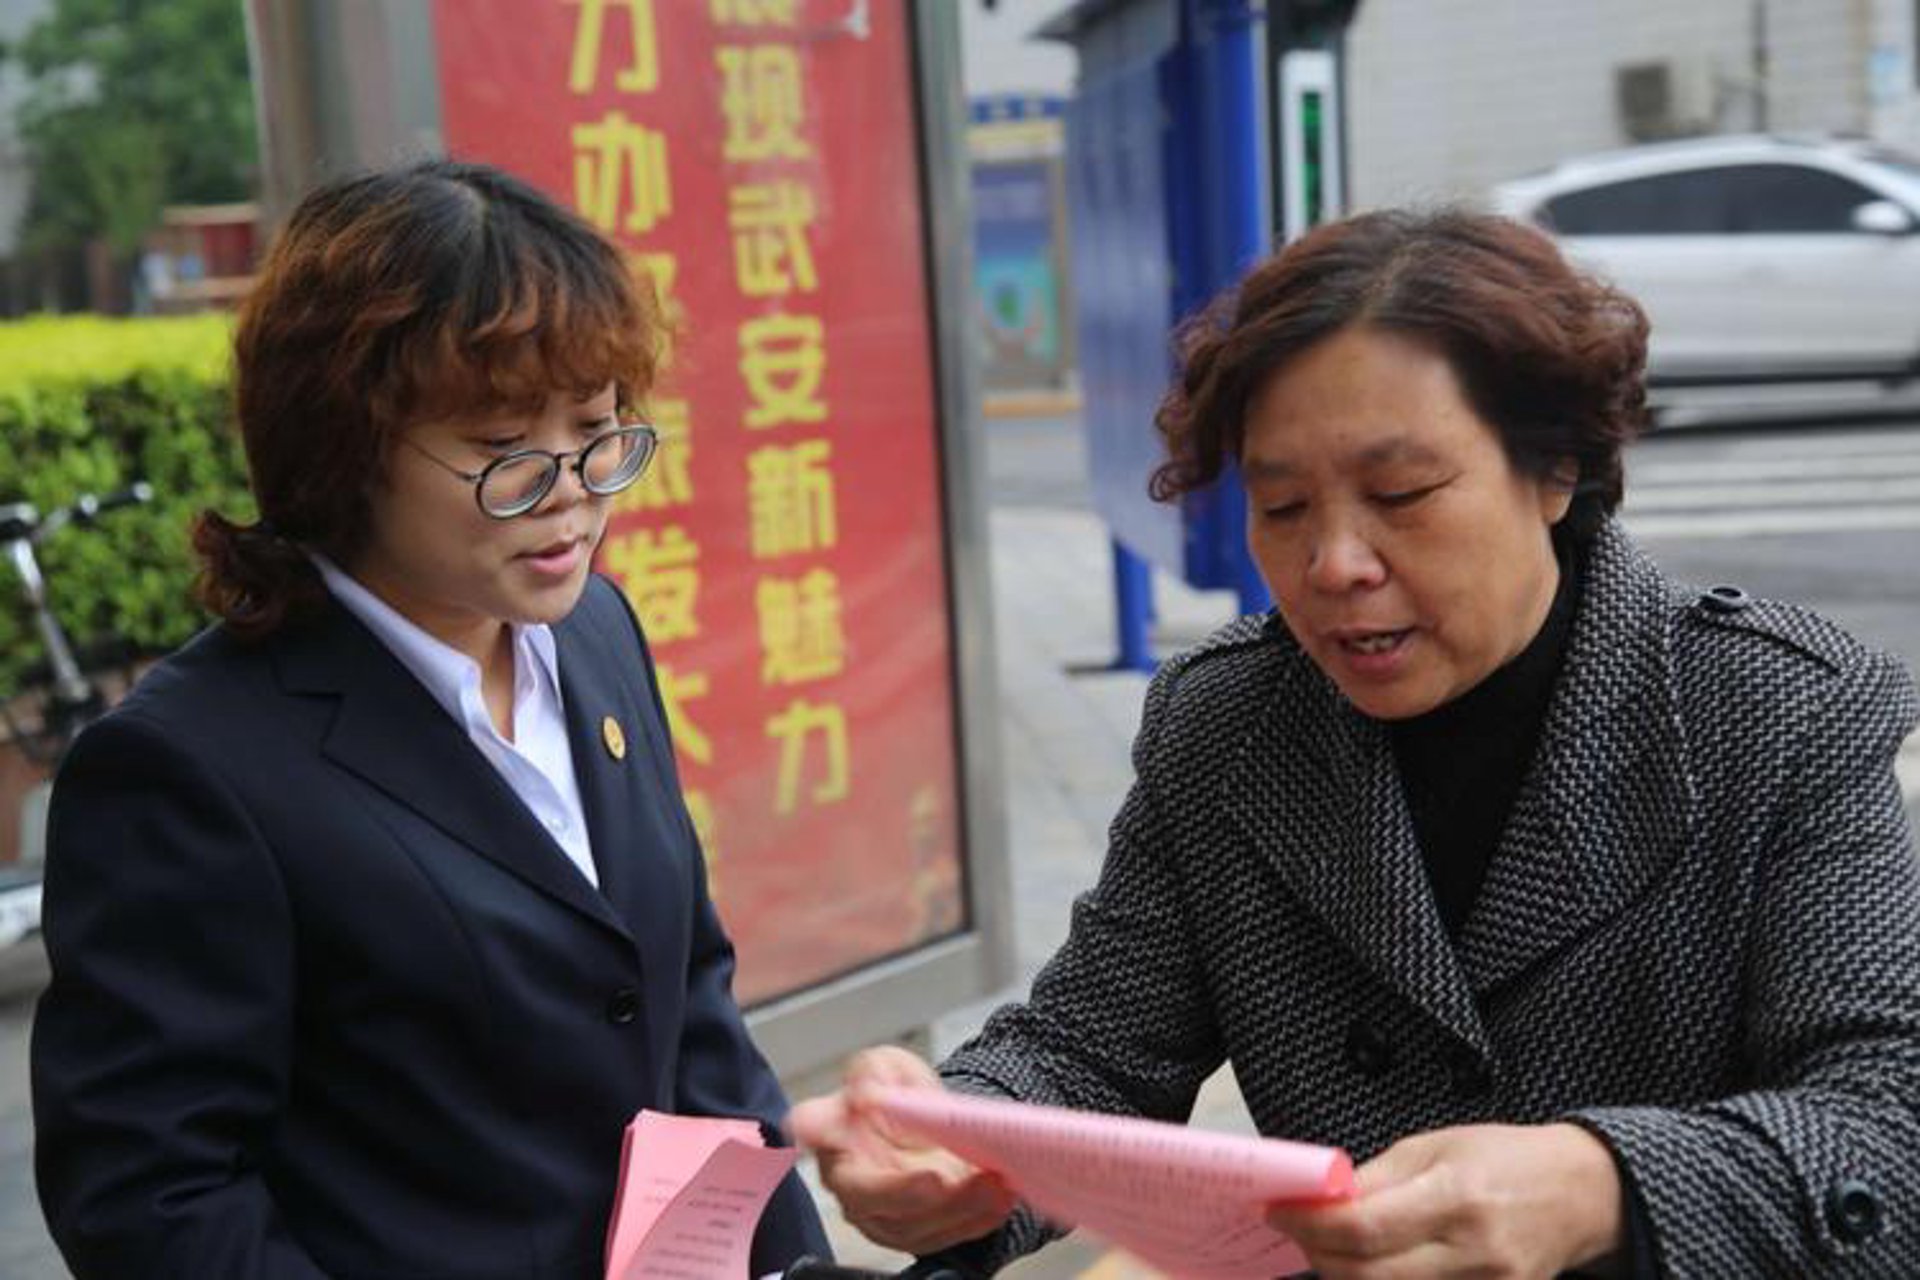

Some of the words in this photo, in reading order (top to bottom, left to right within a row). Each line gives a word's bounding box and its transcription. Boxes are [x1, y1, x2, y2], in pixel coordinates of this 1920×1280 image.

[711, 0, 849, 815] 现武安新魅力
